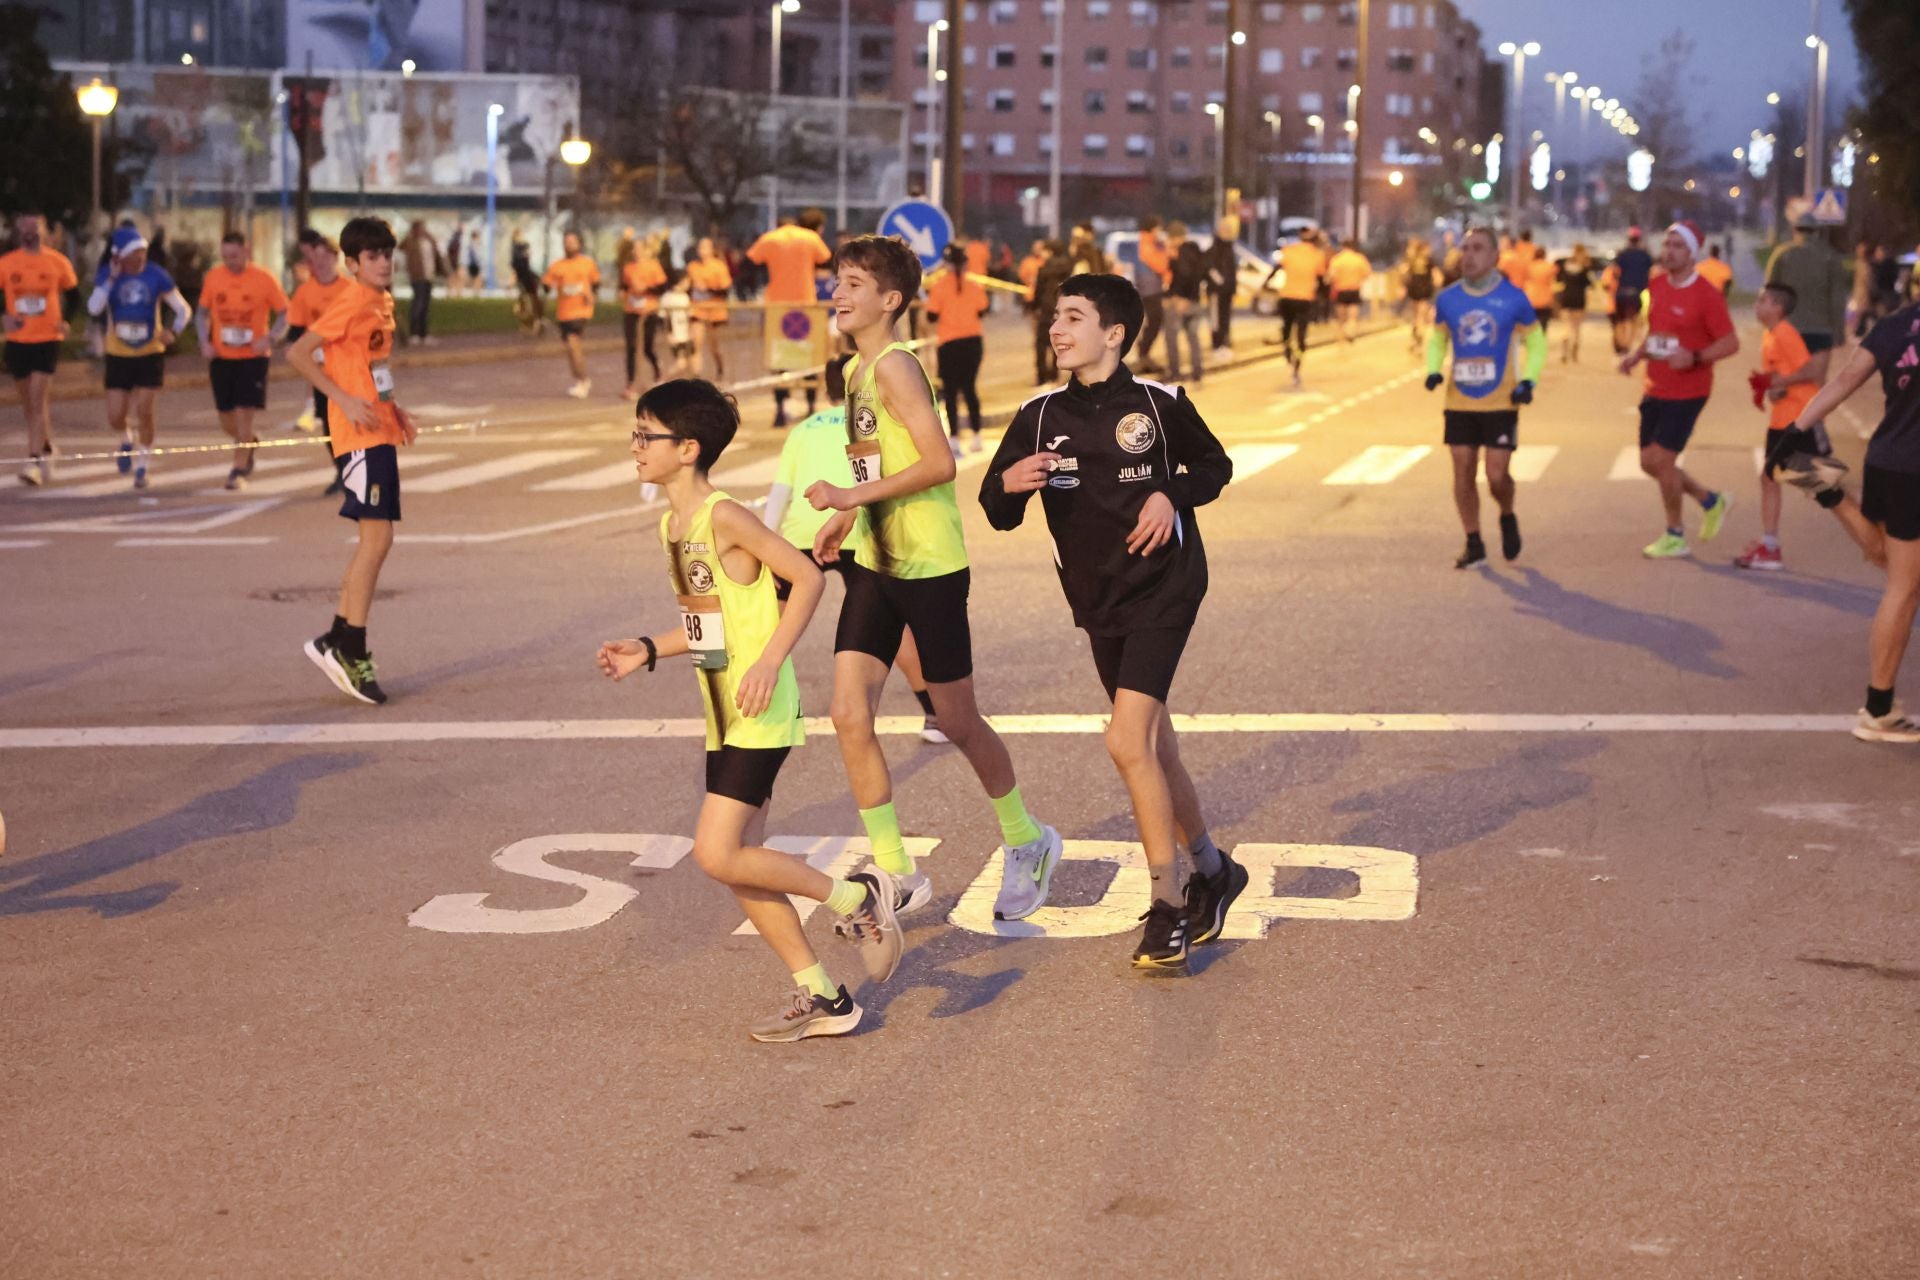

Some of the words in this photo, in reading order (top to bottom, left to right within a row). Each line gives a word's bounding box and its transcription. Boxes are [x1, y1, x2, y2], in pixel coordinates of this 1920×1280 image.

[852, 459, 868, 482] 96
[1118, 463, 1152, 478] JULIÁN
[686, 614, 703, 641] 98
[407, 832, 1419, 940] STOP
